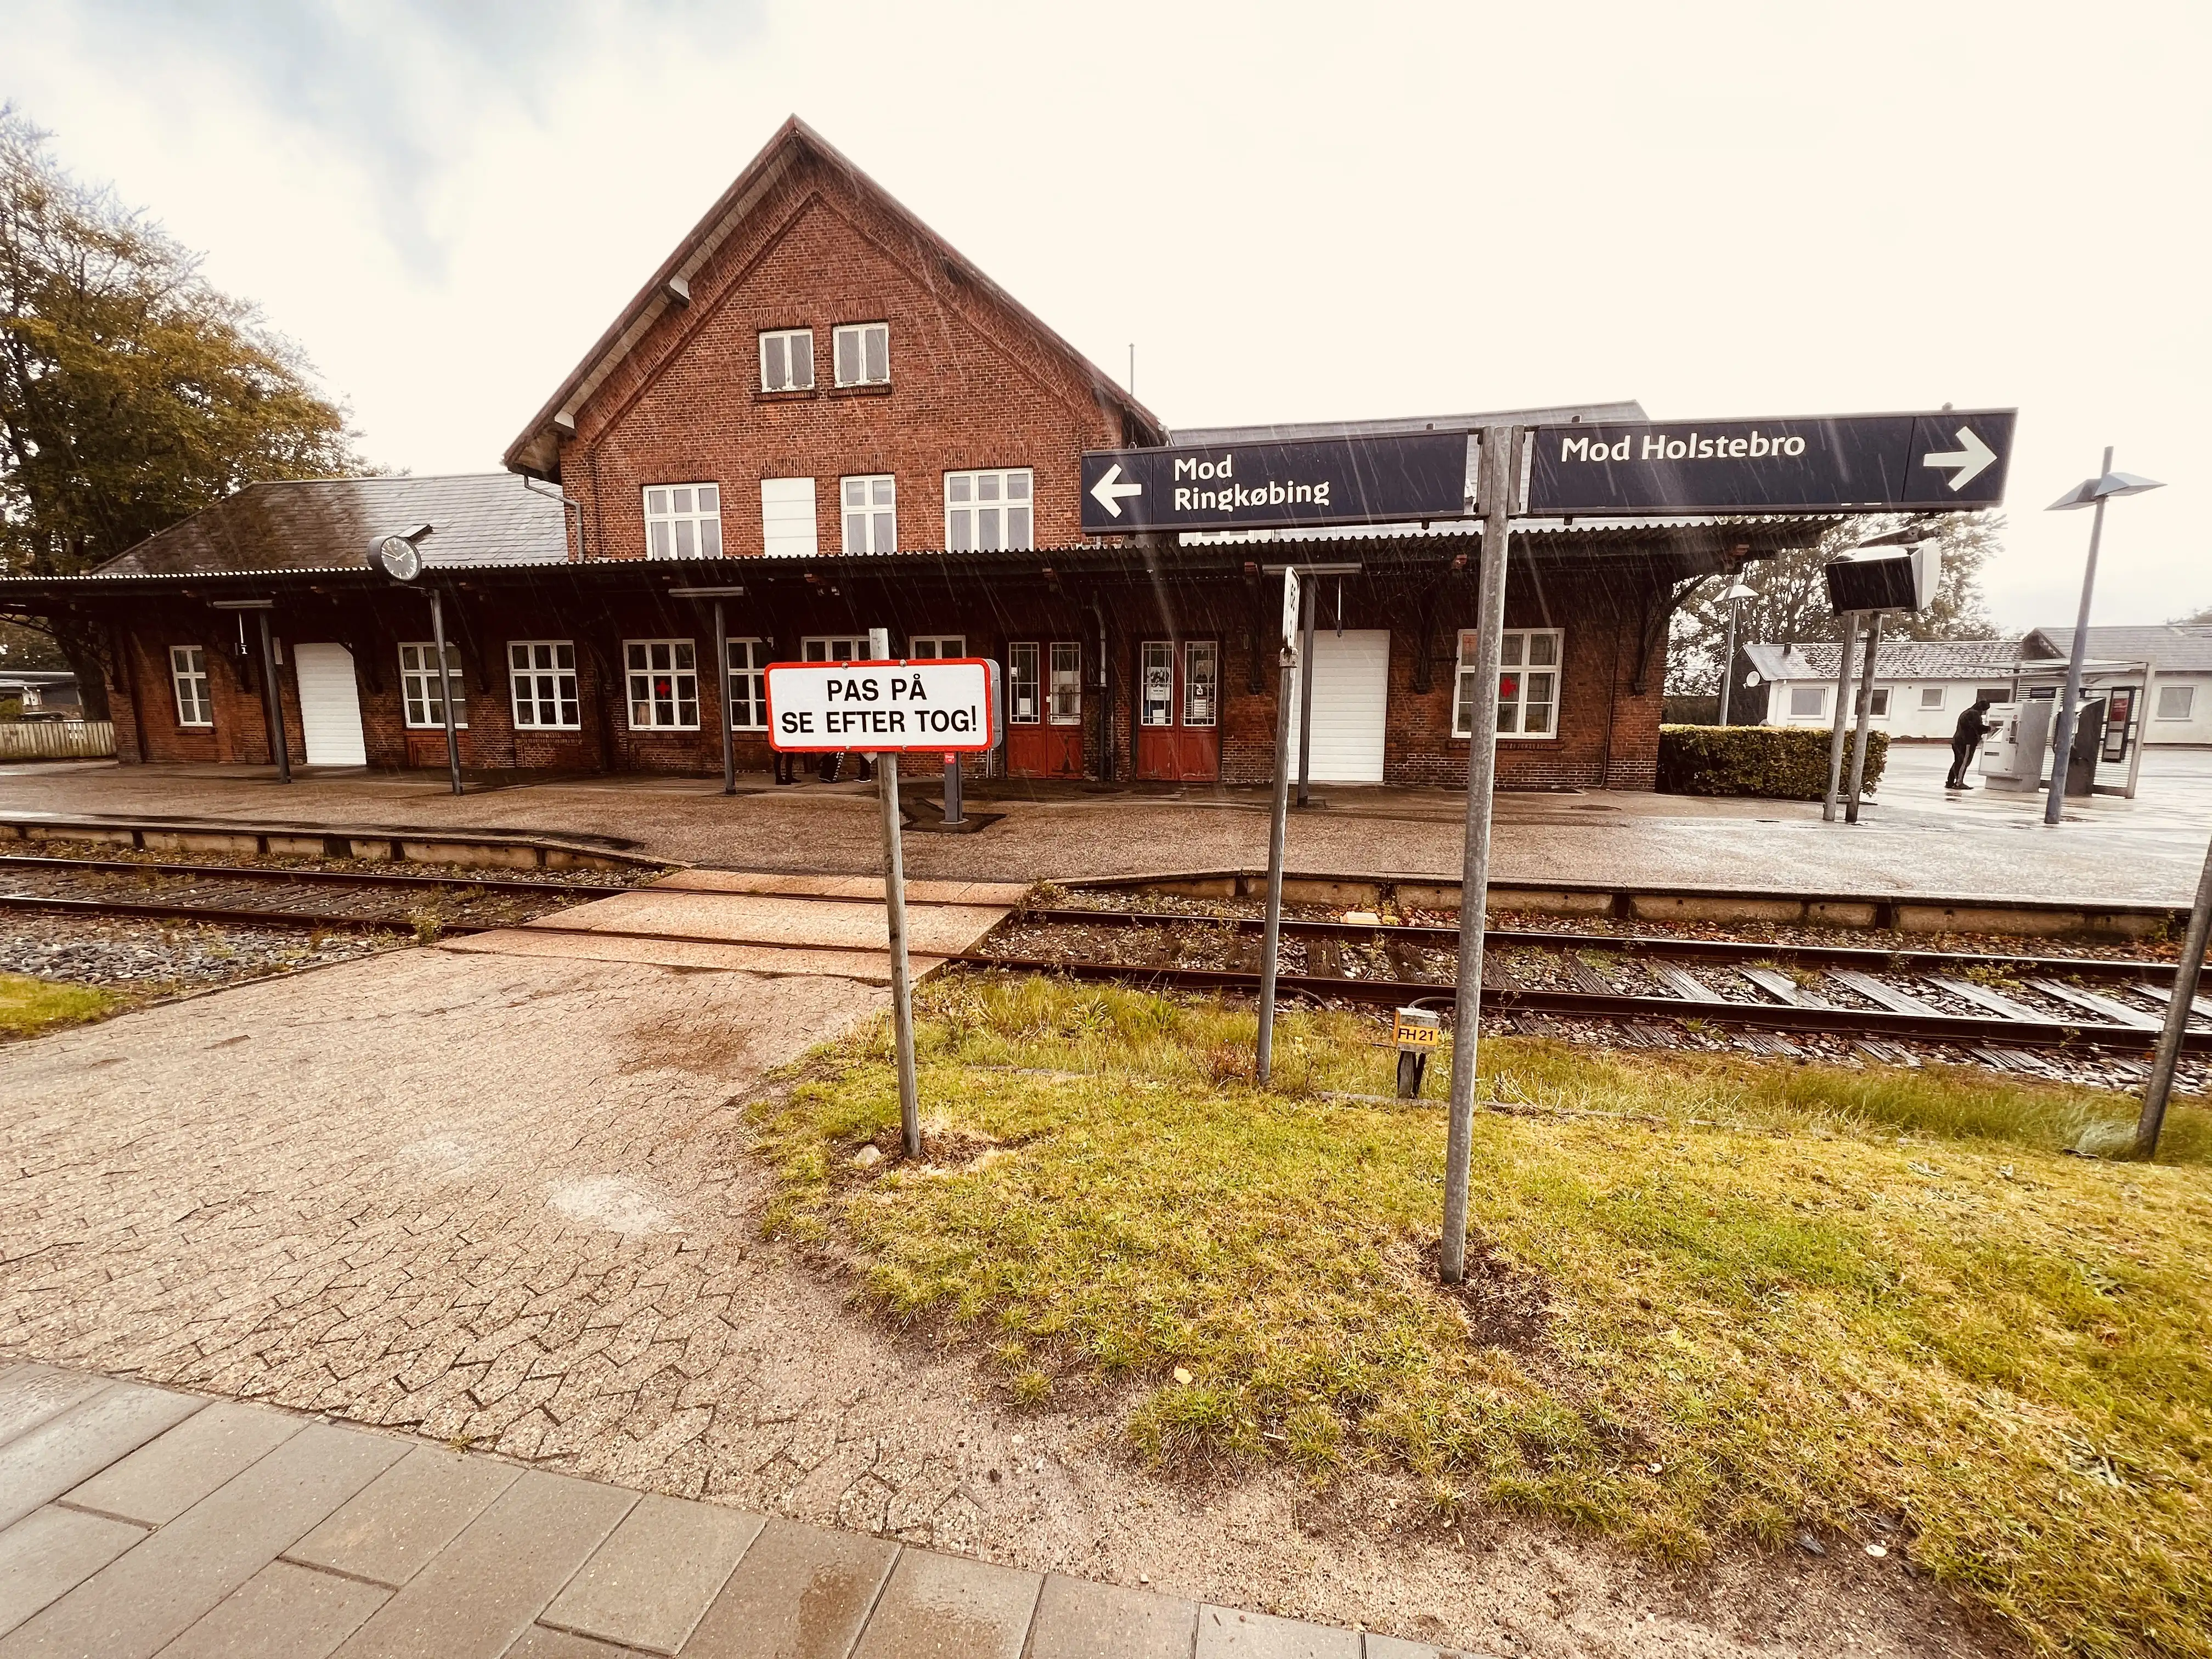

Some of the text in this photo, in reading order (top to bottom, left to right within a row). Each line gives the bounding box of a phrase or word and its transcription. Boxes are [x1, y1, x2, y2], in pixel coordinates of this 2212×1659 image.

[1561, 431, 1806, 462] Mod Holstebro
[1175, 454, 1233, 481] Mod
[1175, 481, 1330, 512] Ringkøbing
[827, 673, 927, 702] PAS PÅ
[782, 706, 977, 733] SE EFTER TOG!
[1398, 1028, 1434, 1041] FH 21
